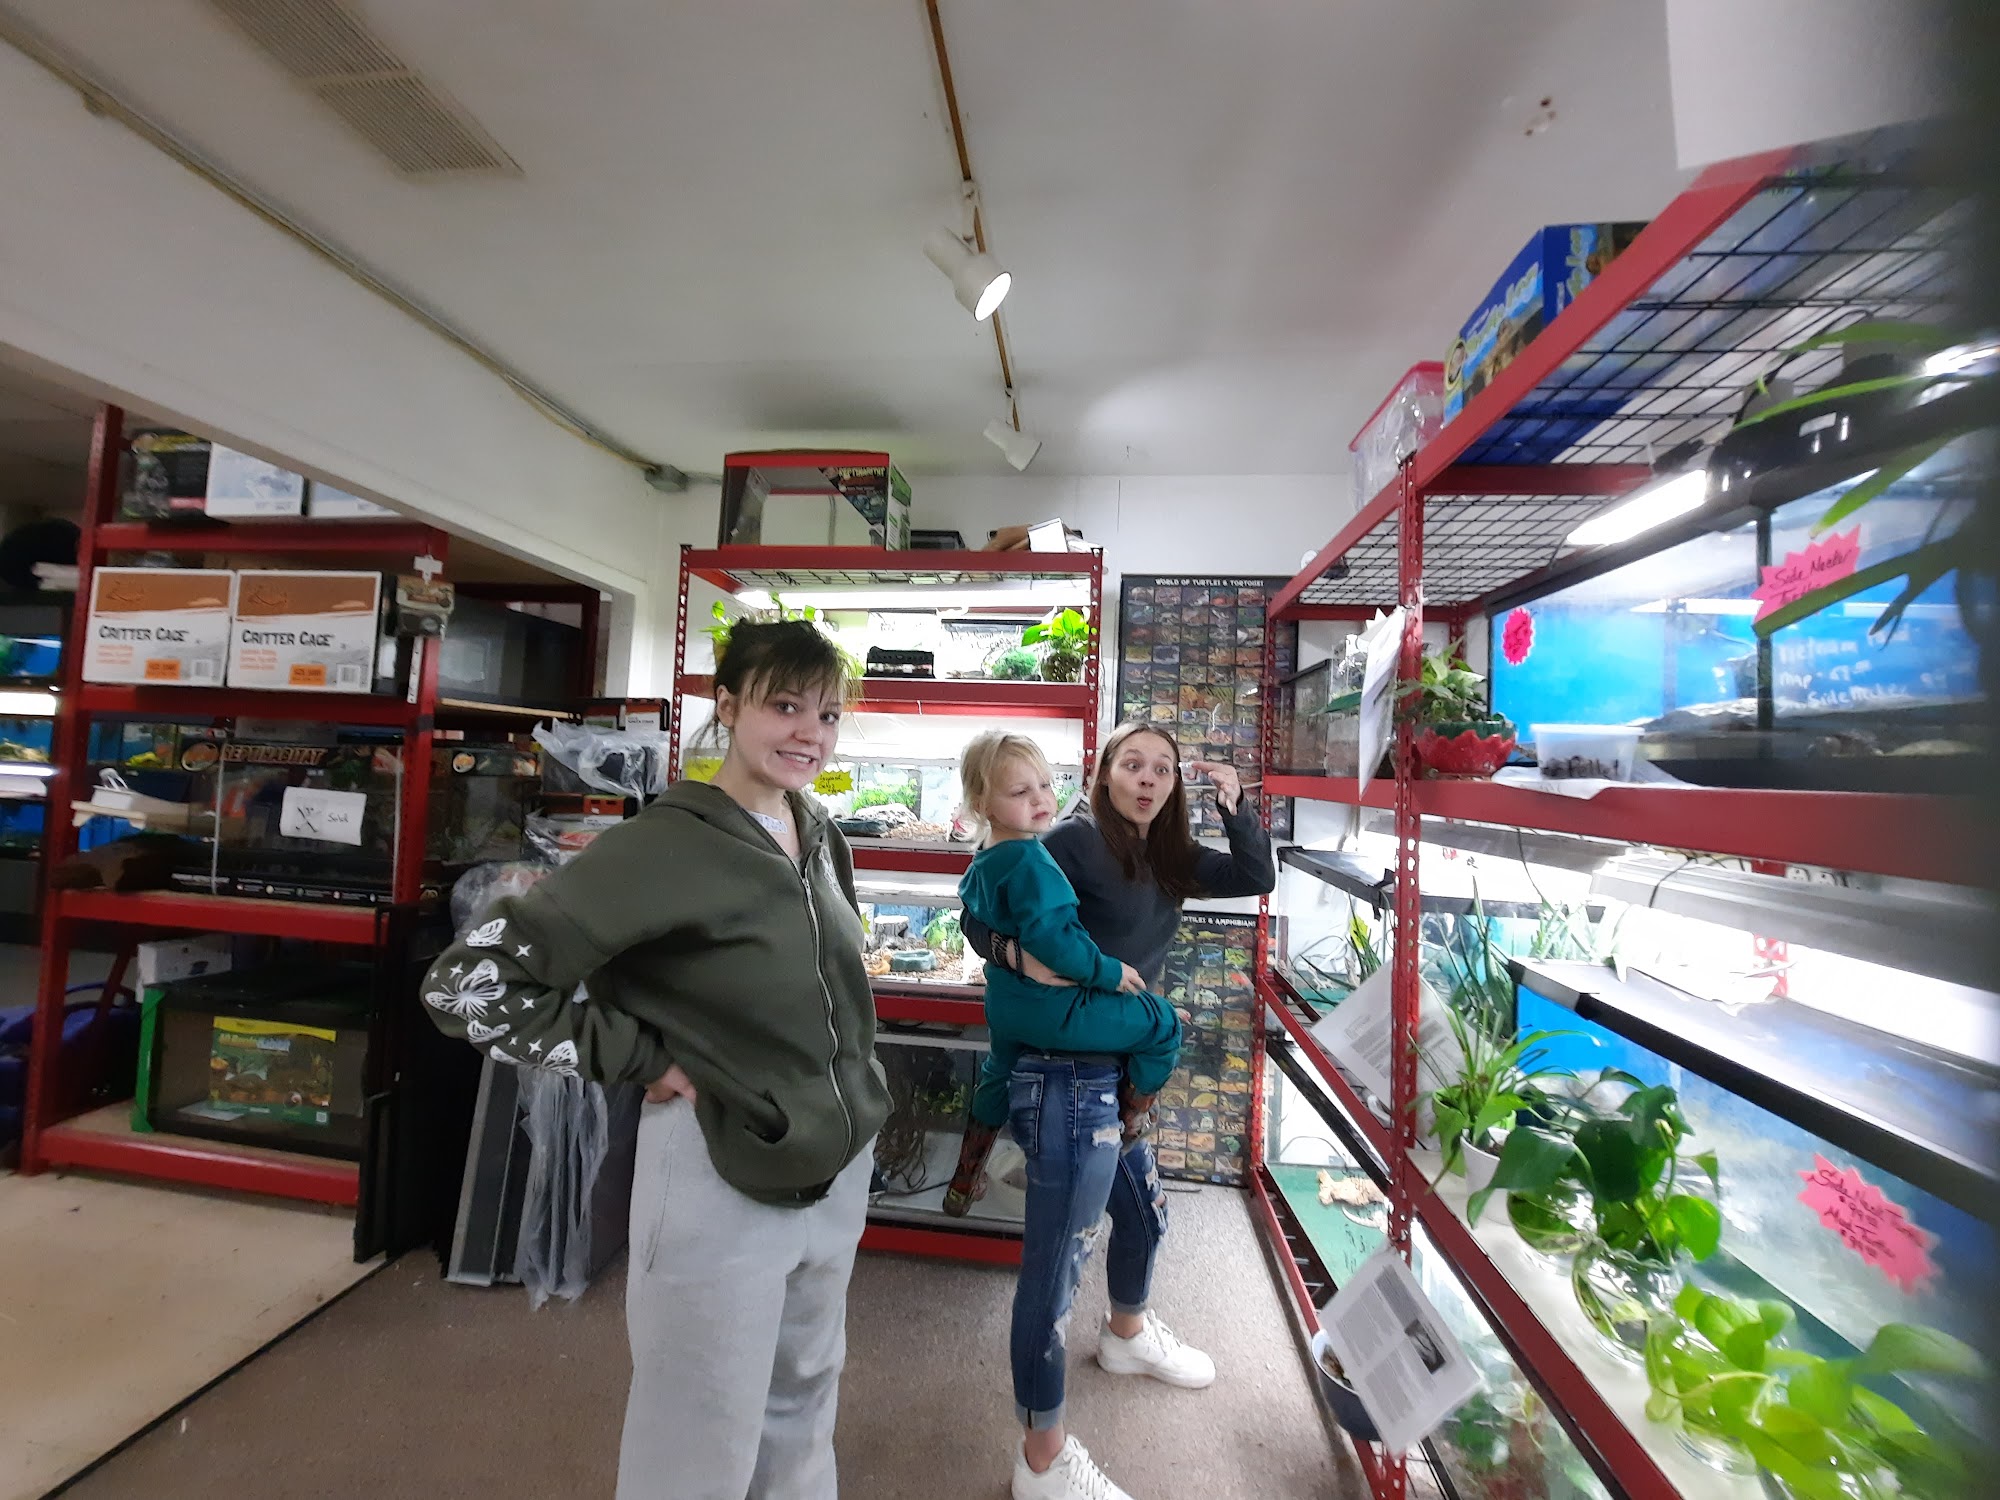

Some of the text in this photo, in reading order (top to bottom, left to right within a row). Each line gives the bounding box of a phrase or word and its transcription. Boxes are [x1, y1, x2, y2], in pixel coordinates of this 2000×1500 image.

[1155, 578, 1180, 586] WORLD
[1193, 579, 1221, 587] TURTLES
[99, 625, 186, 641] CRITTER CAGE
[242, 629, 332, 647] CRITTER CAGE
[1215, 918, 1257, 927] AMPHIBIANS
